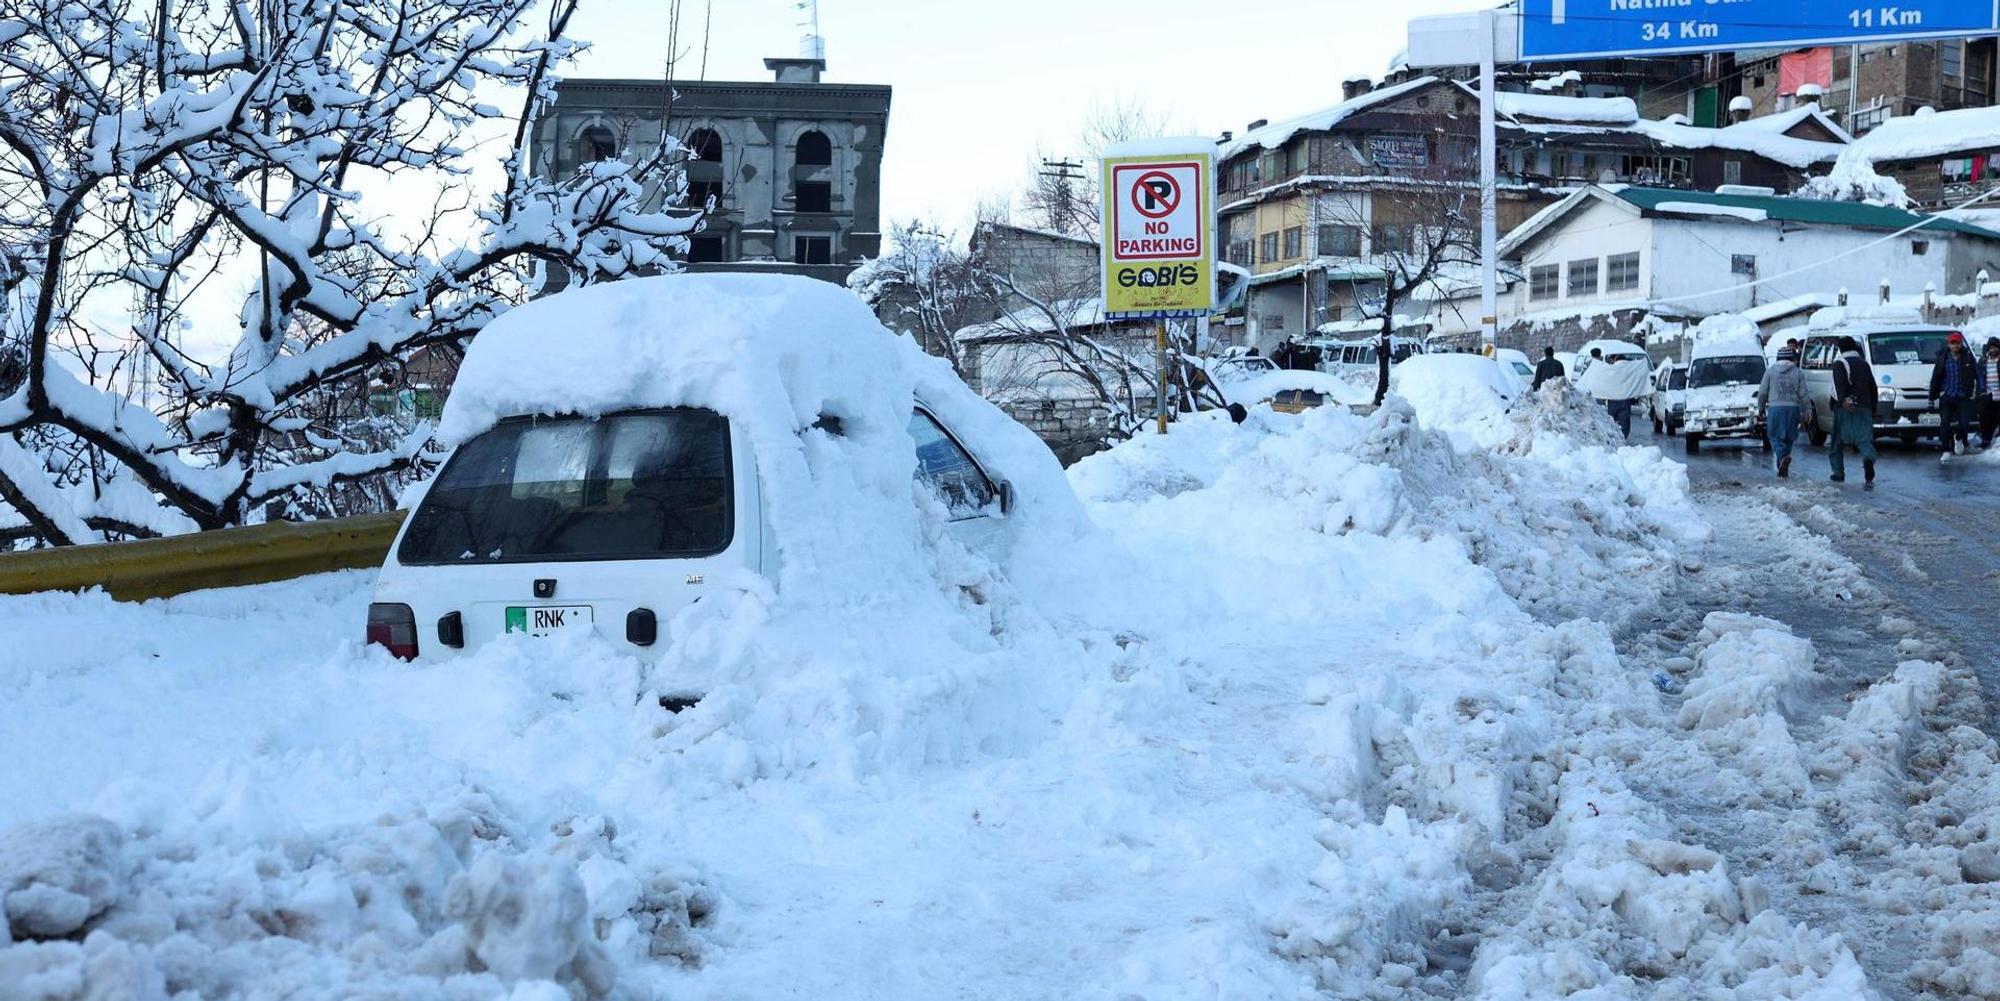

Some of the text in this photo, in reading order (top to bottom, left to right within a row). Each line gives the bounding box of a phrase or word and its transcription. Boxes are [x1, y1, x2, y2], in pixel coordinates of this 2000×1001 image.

[1848, 7, 1922, 27] 11 Km
[1641, 20, 1719, 41] 34 Km
[1144, 181, 1172, 209] P
[1145, 221, 1169, 235] NO
[1119, 238, 1195, 253] PARKING
[1117, 263, 1199, 288] GOBI'S
[534, 610, 565, 629] RNK
